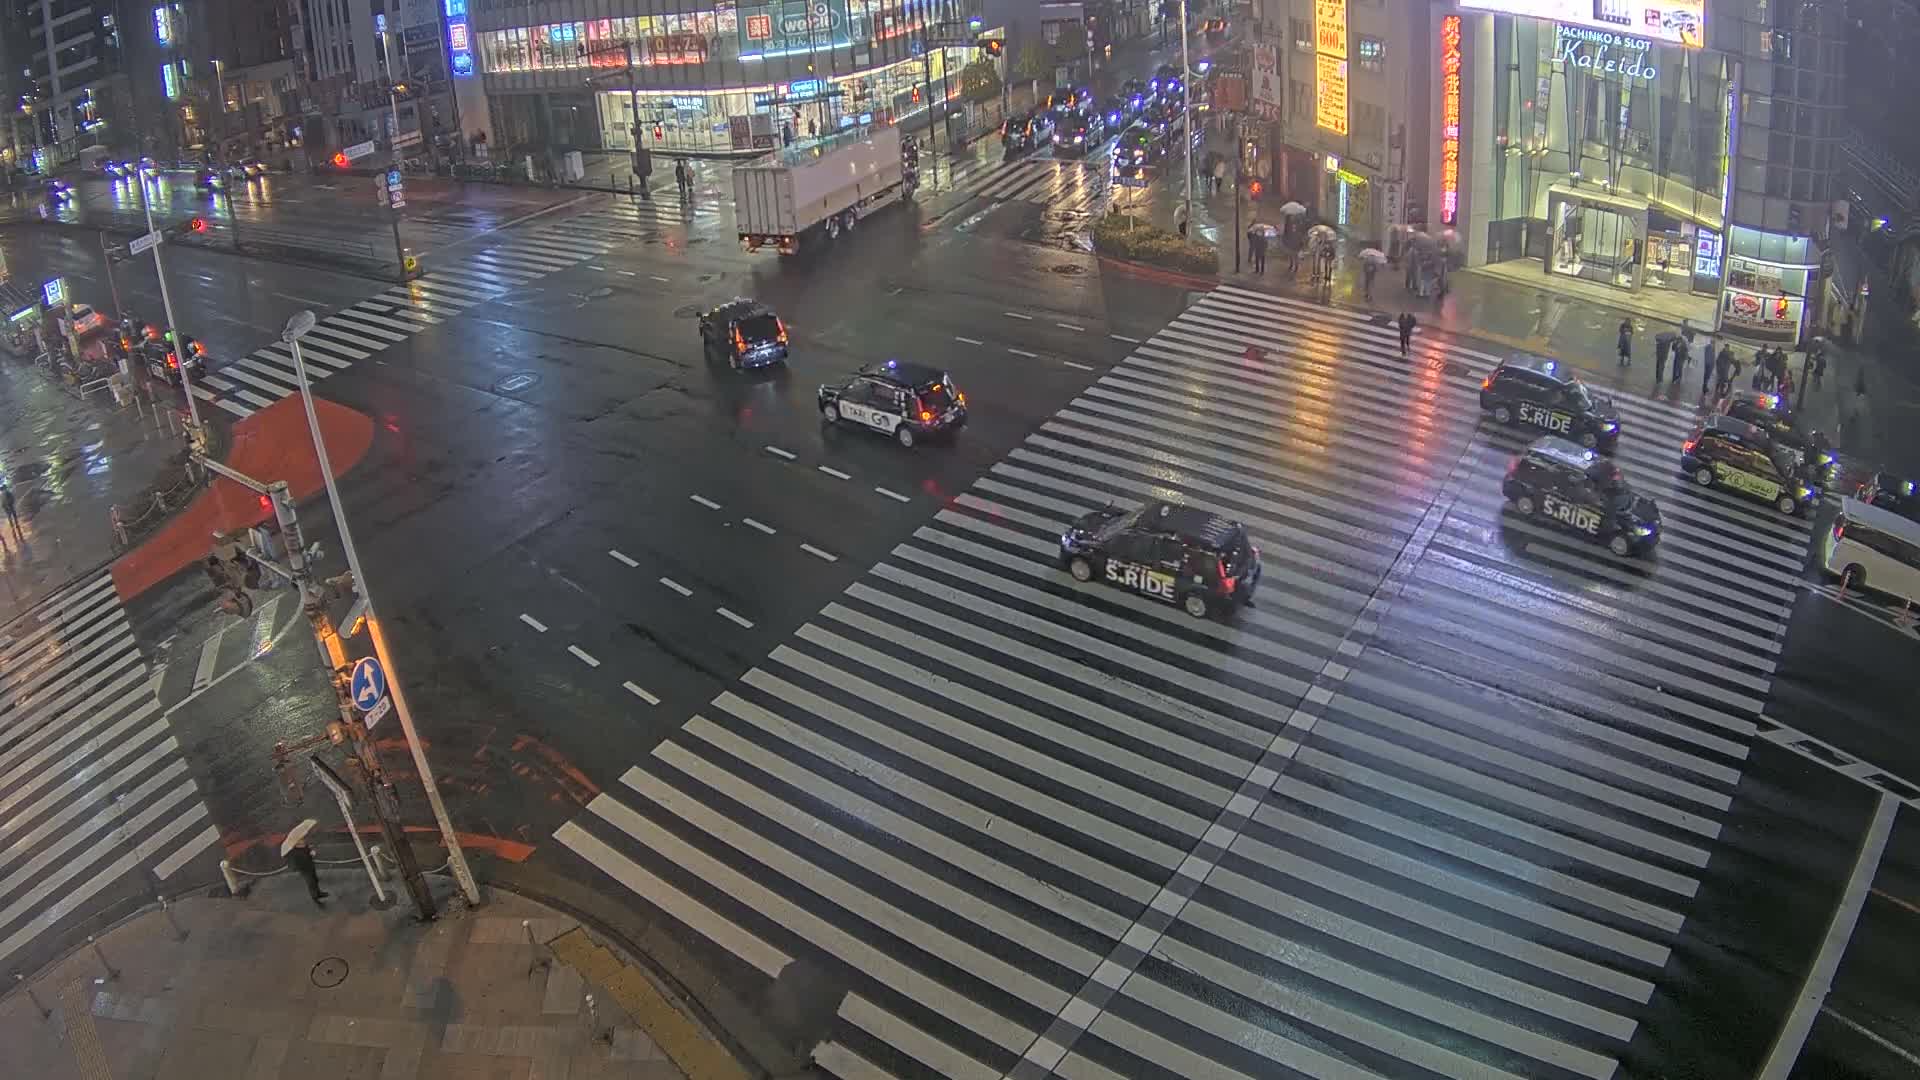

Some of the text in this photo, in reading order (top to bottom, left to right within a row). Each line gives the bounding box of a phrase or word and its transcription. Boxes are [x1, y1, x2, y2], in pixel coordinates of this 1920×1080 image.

[1556, 26, 1652, 51] PACHINKO & SLOT
[1551, 38, 1656, 80] Kaleido
[1519, 407, 1572, 434] S.RIDE
[1543, 500, 1601, 535] S.RIDE
[1105, 564, 1175, 598] S.RIDE
